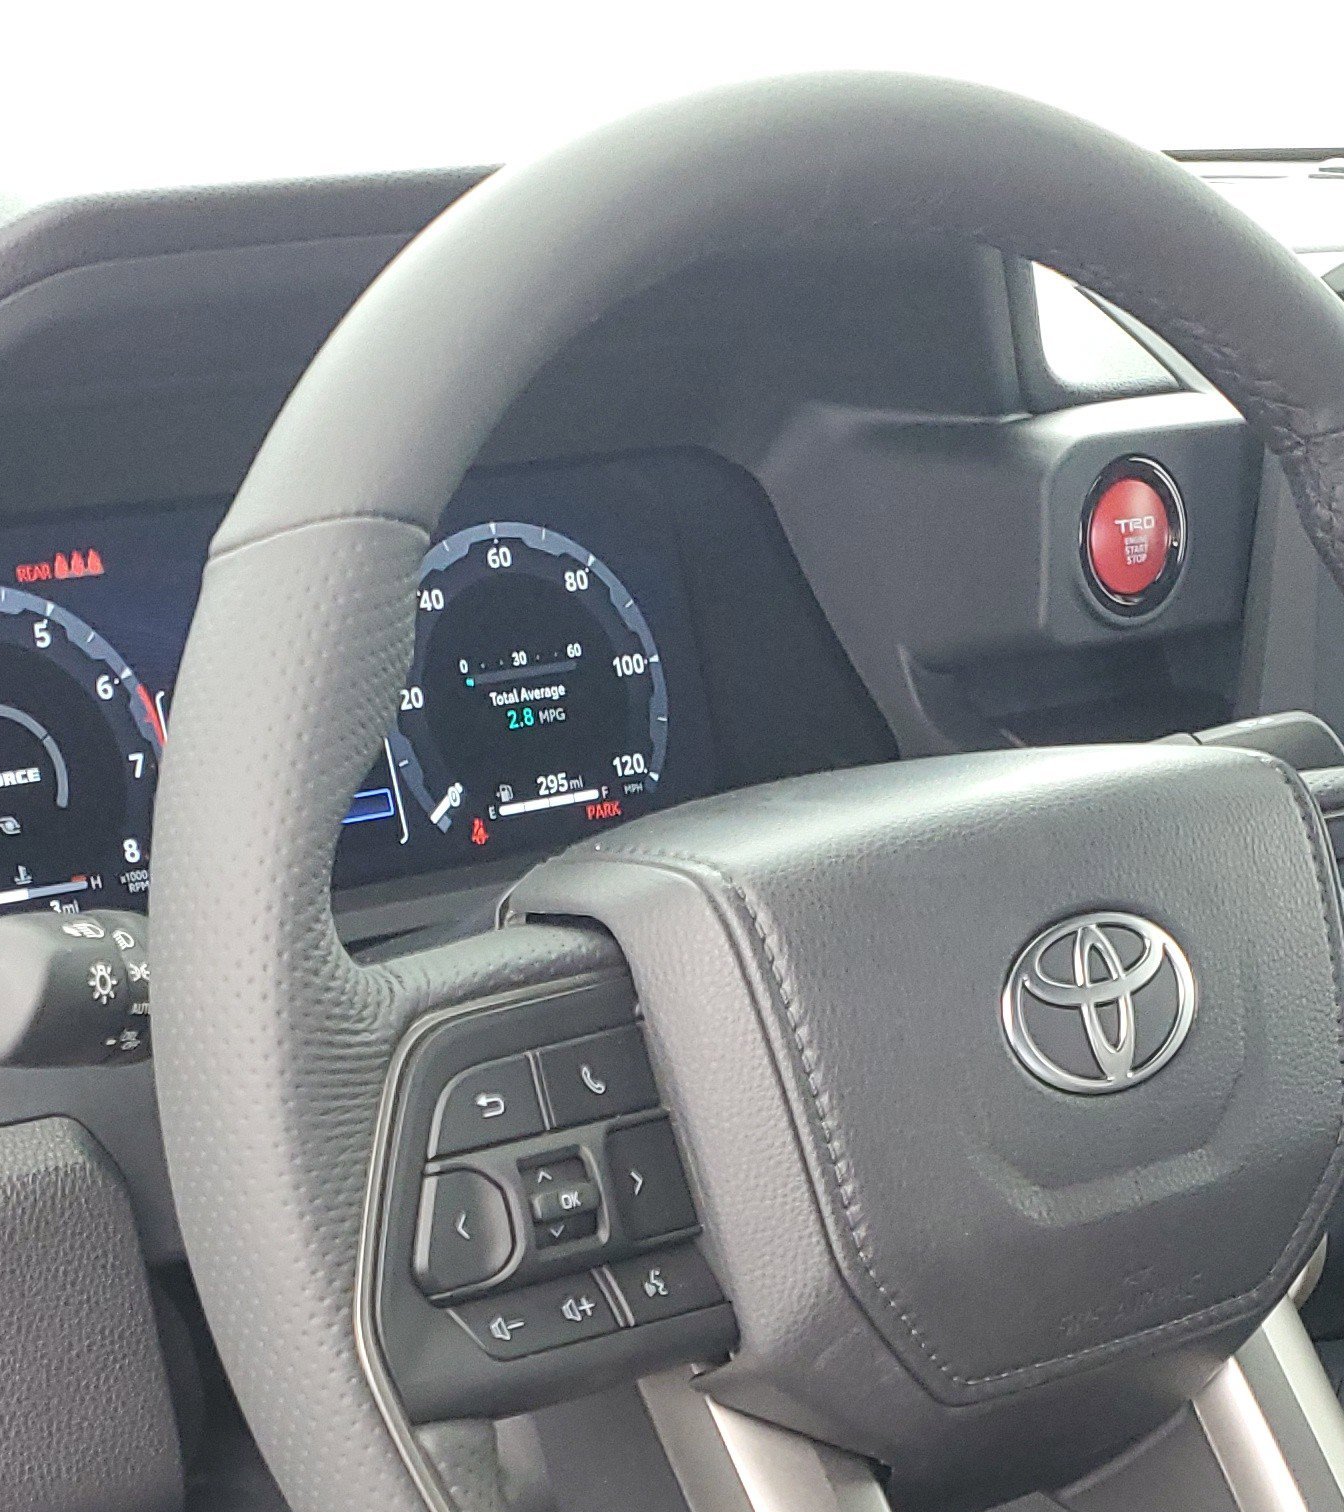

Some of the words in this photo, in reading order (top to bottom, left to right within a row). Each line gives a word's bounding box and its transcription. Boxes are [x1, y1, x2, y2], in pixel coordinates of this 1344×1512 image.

[1114, 516, 1155, 534] TRD
[487, 547, 512, 569] 60
[16, 562, 51, 583] REAR
[564, 570, 588, 593] 80
[419, 589, 445, 612] 40
[34, 624, 51, 649] 5
[459, 659, 468, 674] 0
[511, 650, 527, 666] 30
[566, 642, 582, 658] 60
[612, 653, 644, 677] 100
[95, 675, 114, 700] 6
[399, 687, 424, 710] 20
[489, 688, 520, 706] Total
[520, 684, 566, 700] Average
[507, 707, 534, 729] 2.8
[538, 707, 566, 724] MPG
[128, 754, 145, 778] 7
[612, 753, 645, 777] 120
[537, 772, 569, 796] 295
[601, 785, 609, 799] F
[624, 783, 643, 795] MPH
[488, 805, 497, 820] E
[586, 801, 622, 820] PARK
[123, 840, 140, 863] 8
[90, 874, 103, 890] H
[131, 1002, 149, 1015] AUT
[561, 1191, 581, 1209] OK
